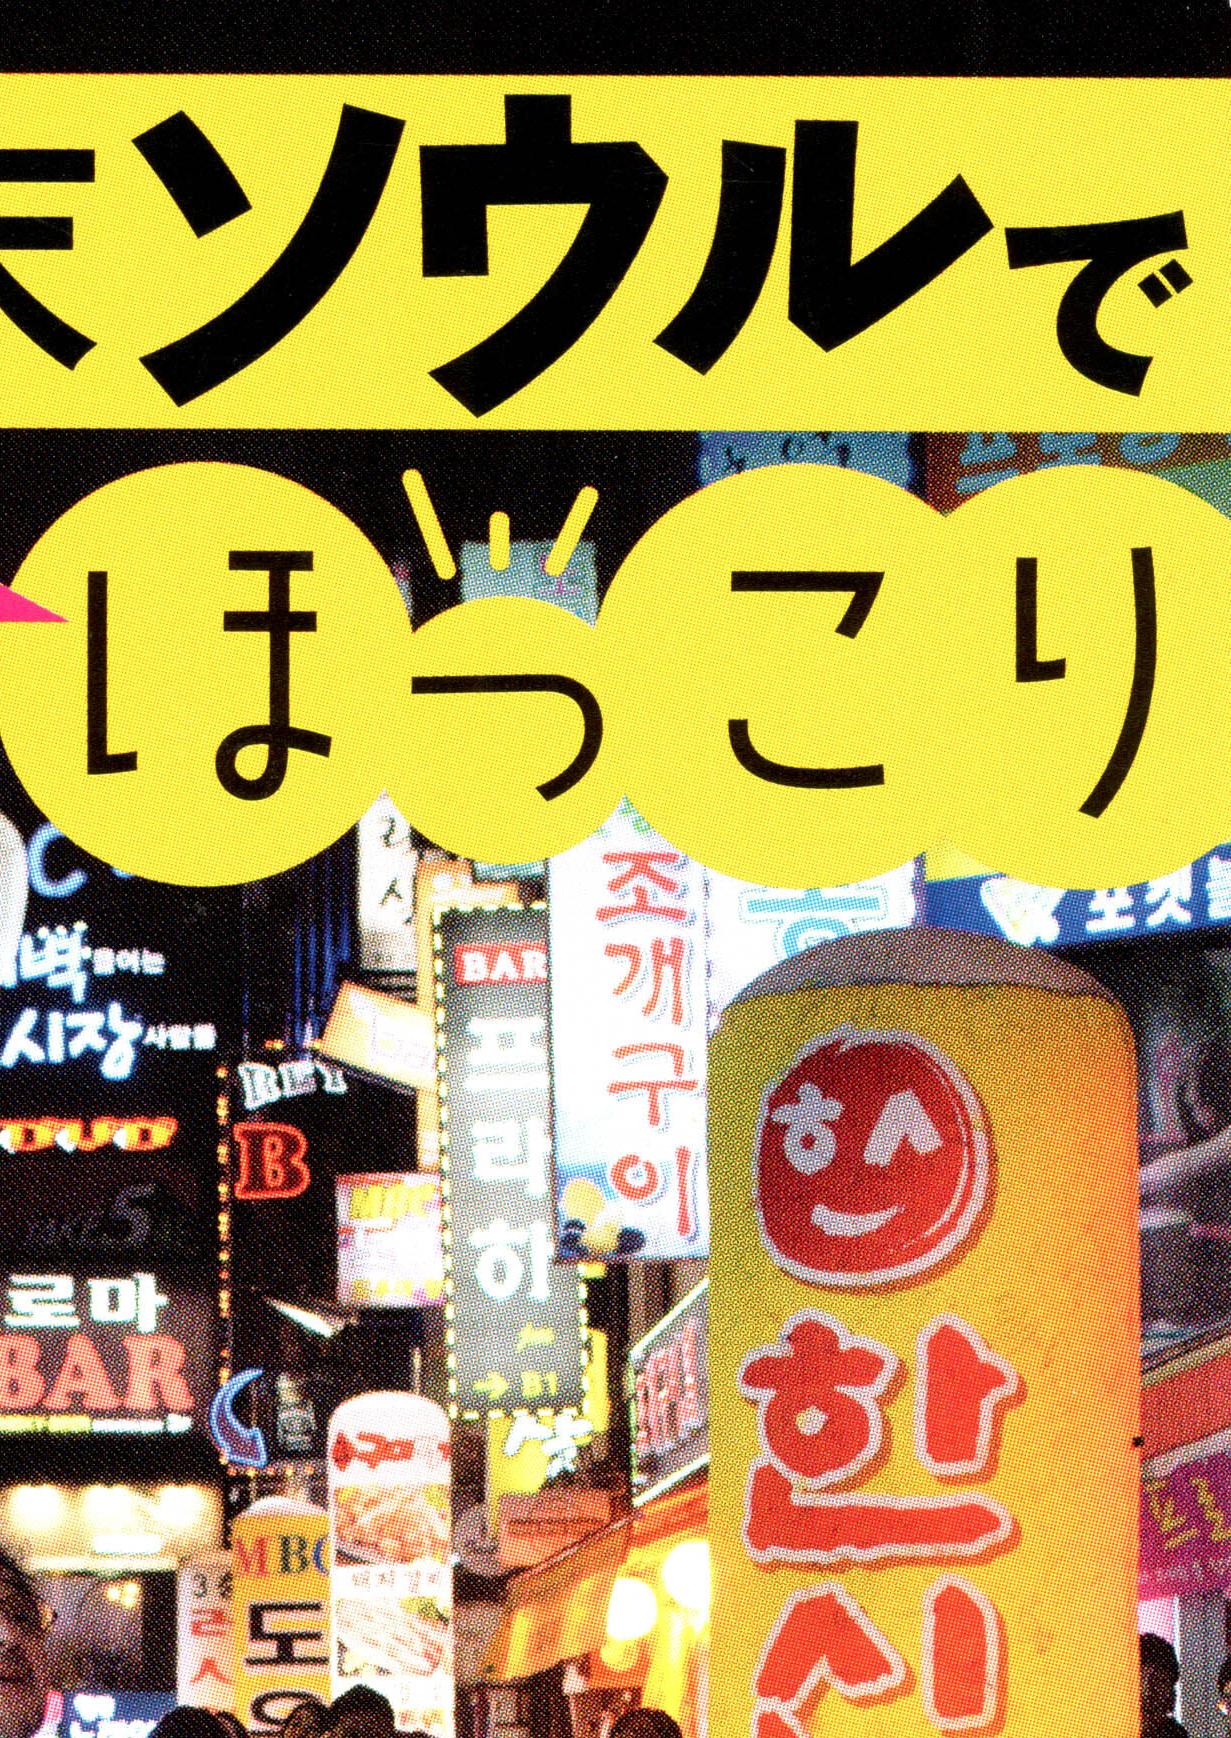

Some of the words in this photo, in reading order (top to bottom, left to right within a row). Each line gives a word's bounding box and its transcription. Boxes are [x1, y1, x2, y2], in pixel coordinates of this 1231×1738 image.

[463, 949, 548, 982] BAR
[596, 850, 699, 1238] 조개구이
[464, 1016, 556, 1303] 프라하
[3, 1271, 170, 1334] 로마
[520, 1371, 558, 1397] B1
